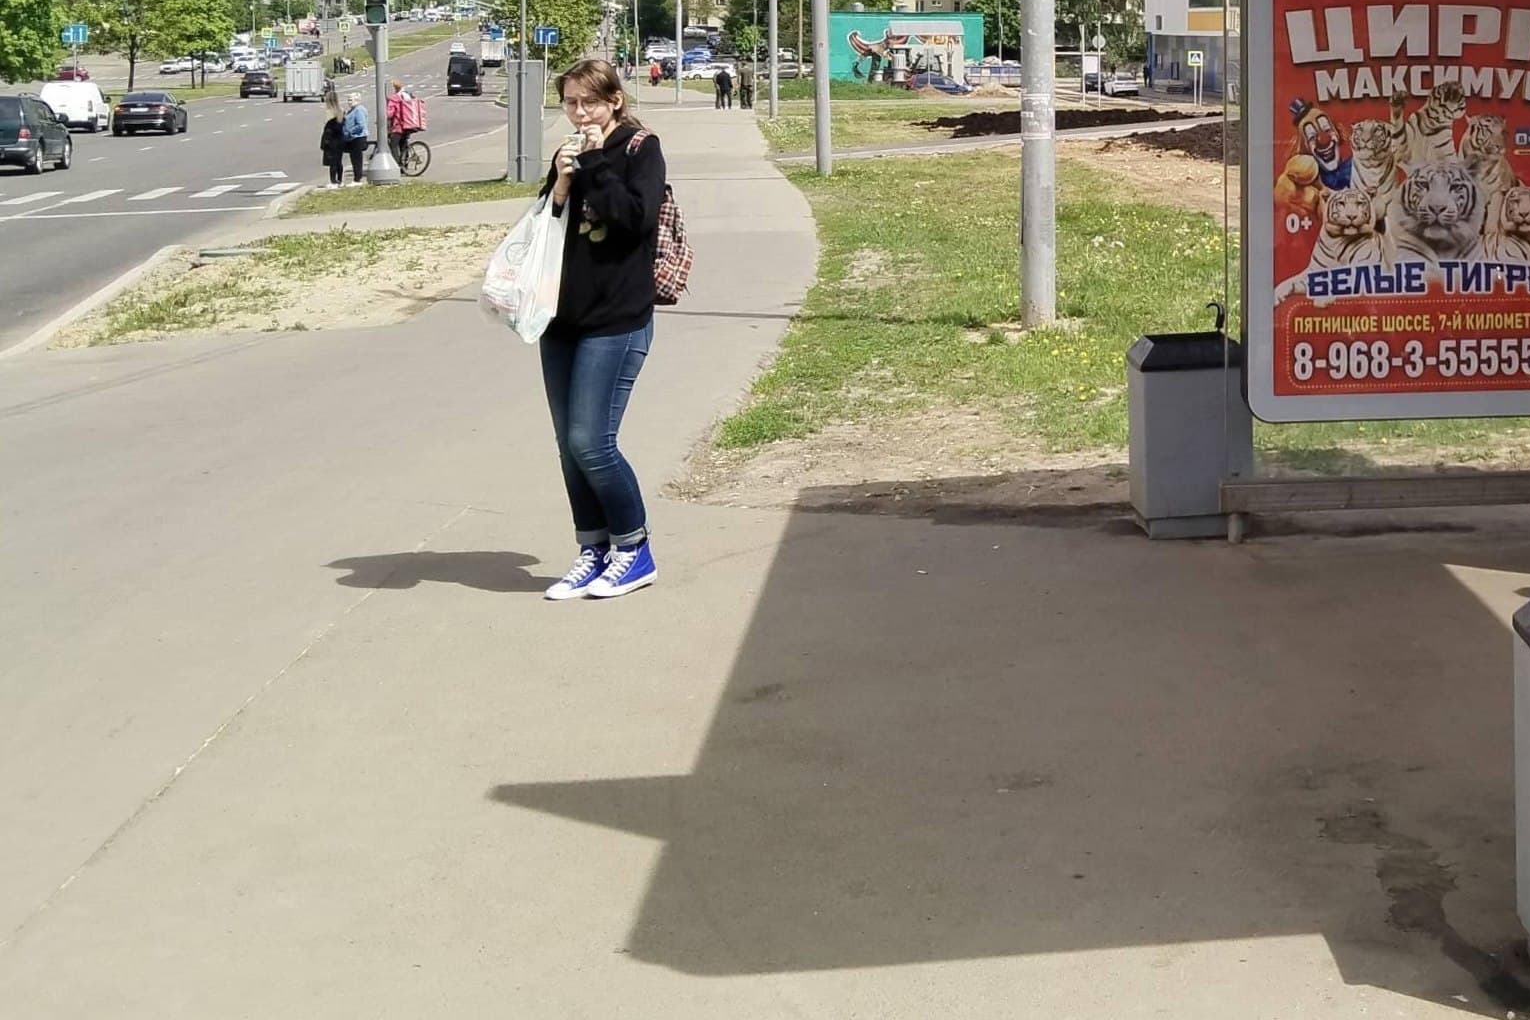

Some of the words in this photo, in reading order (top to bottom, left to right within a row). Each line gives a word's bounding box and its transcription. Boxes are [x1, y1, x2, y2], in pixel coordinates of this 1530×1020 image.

[1286, 213, 1312, 233] 0+
[1308, 262, 1426, 296] БЕЛЫЕ
[1294, 316, 1378, 333] ПЯТНИЦКОЕ
[1382, 315, 1434, 332] ШОССЕ,
[1439, 310, 1461, 331] 7-Й
